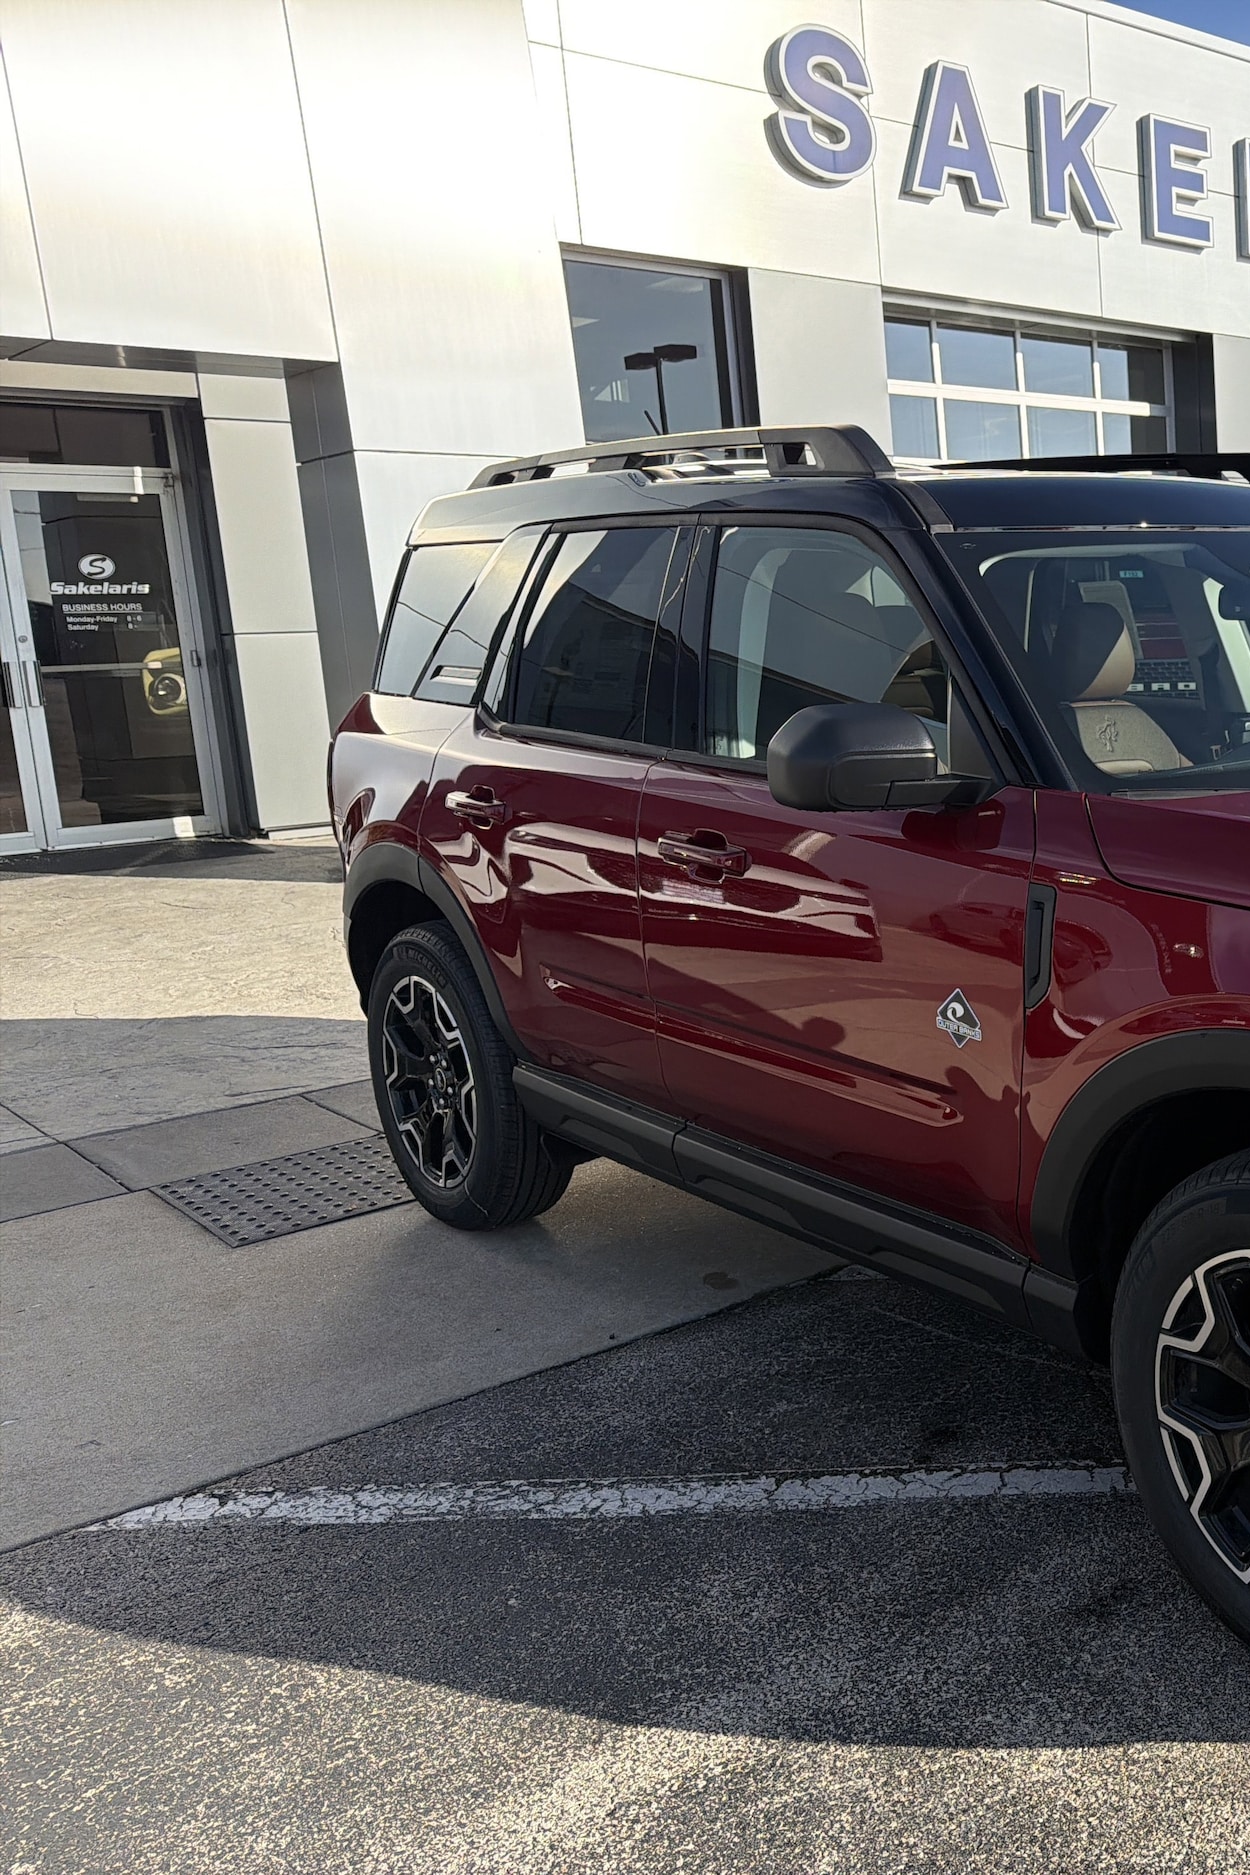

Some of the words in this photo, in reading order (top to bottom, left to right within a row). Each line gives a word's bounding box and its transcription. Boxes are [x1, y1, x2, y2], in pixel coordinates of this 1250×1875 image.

[50, 581, 150, 595] Sakelaris
[62, 603, 108, 613] BUSINESS
[110, 602, 142, 611] HOURS
[66, 615, 118, 624] Monday-Friday
[67, 623, 99, 632] Saturday
